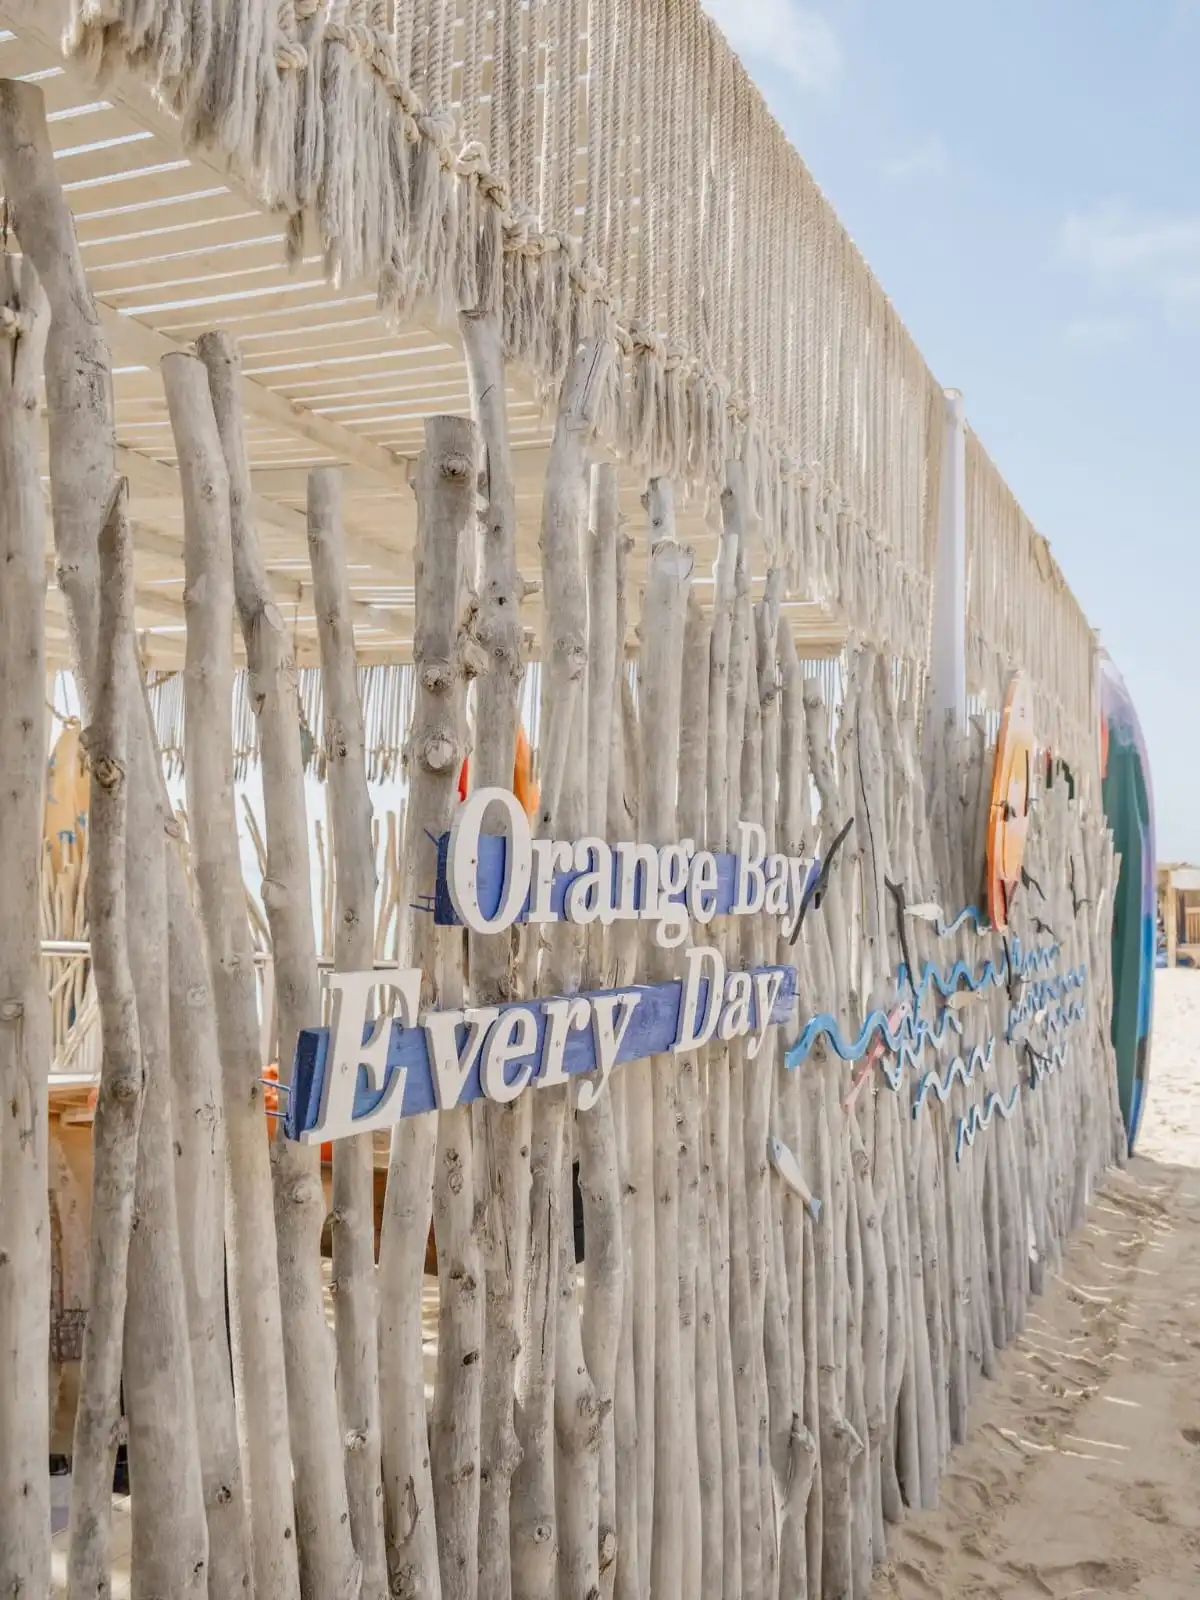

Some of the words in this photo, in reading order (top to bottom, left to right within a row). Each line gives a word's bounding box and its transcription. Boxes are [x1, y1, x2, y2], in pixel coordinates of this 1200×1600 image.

[448, 786, 719, 948] Orange
[732, 821, 815, 937] Bay
[301, 969, 640, 1144] Every
[674, 947, 783, 1059] Day
